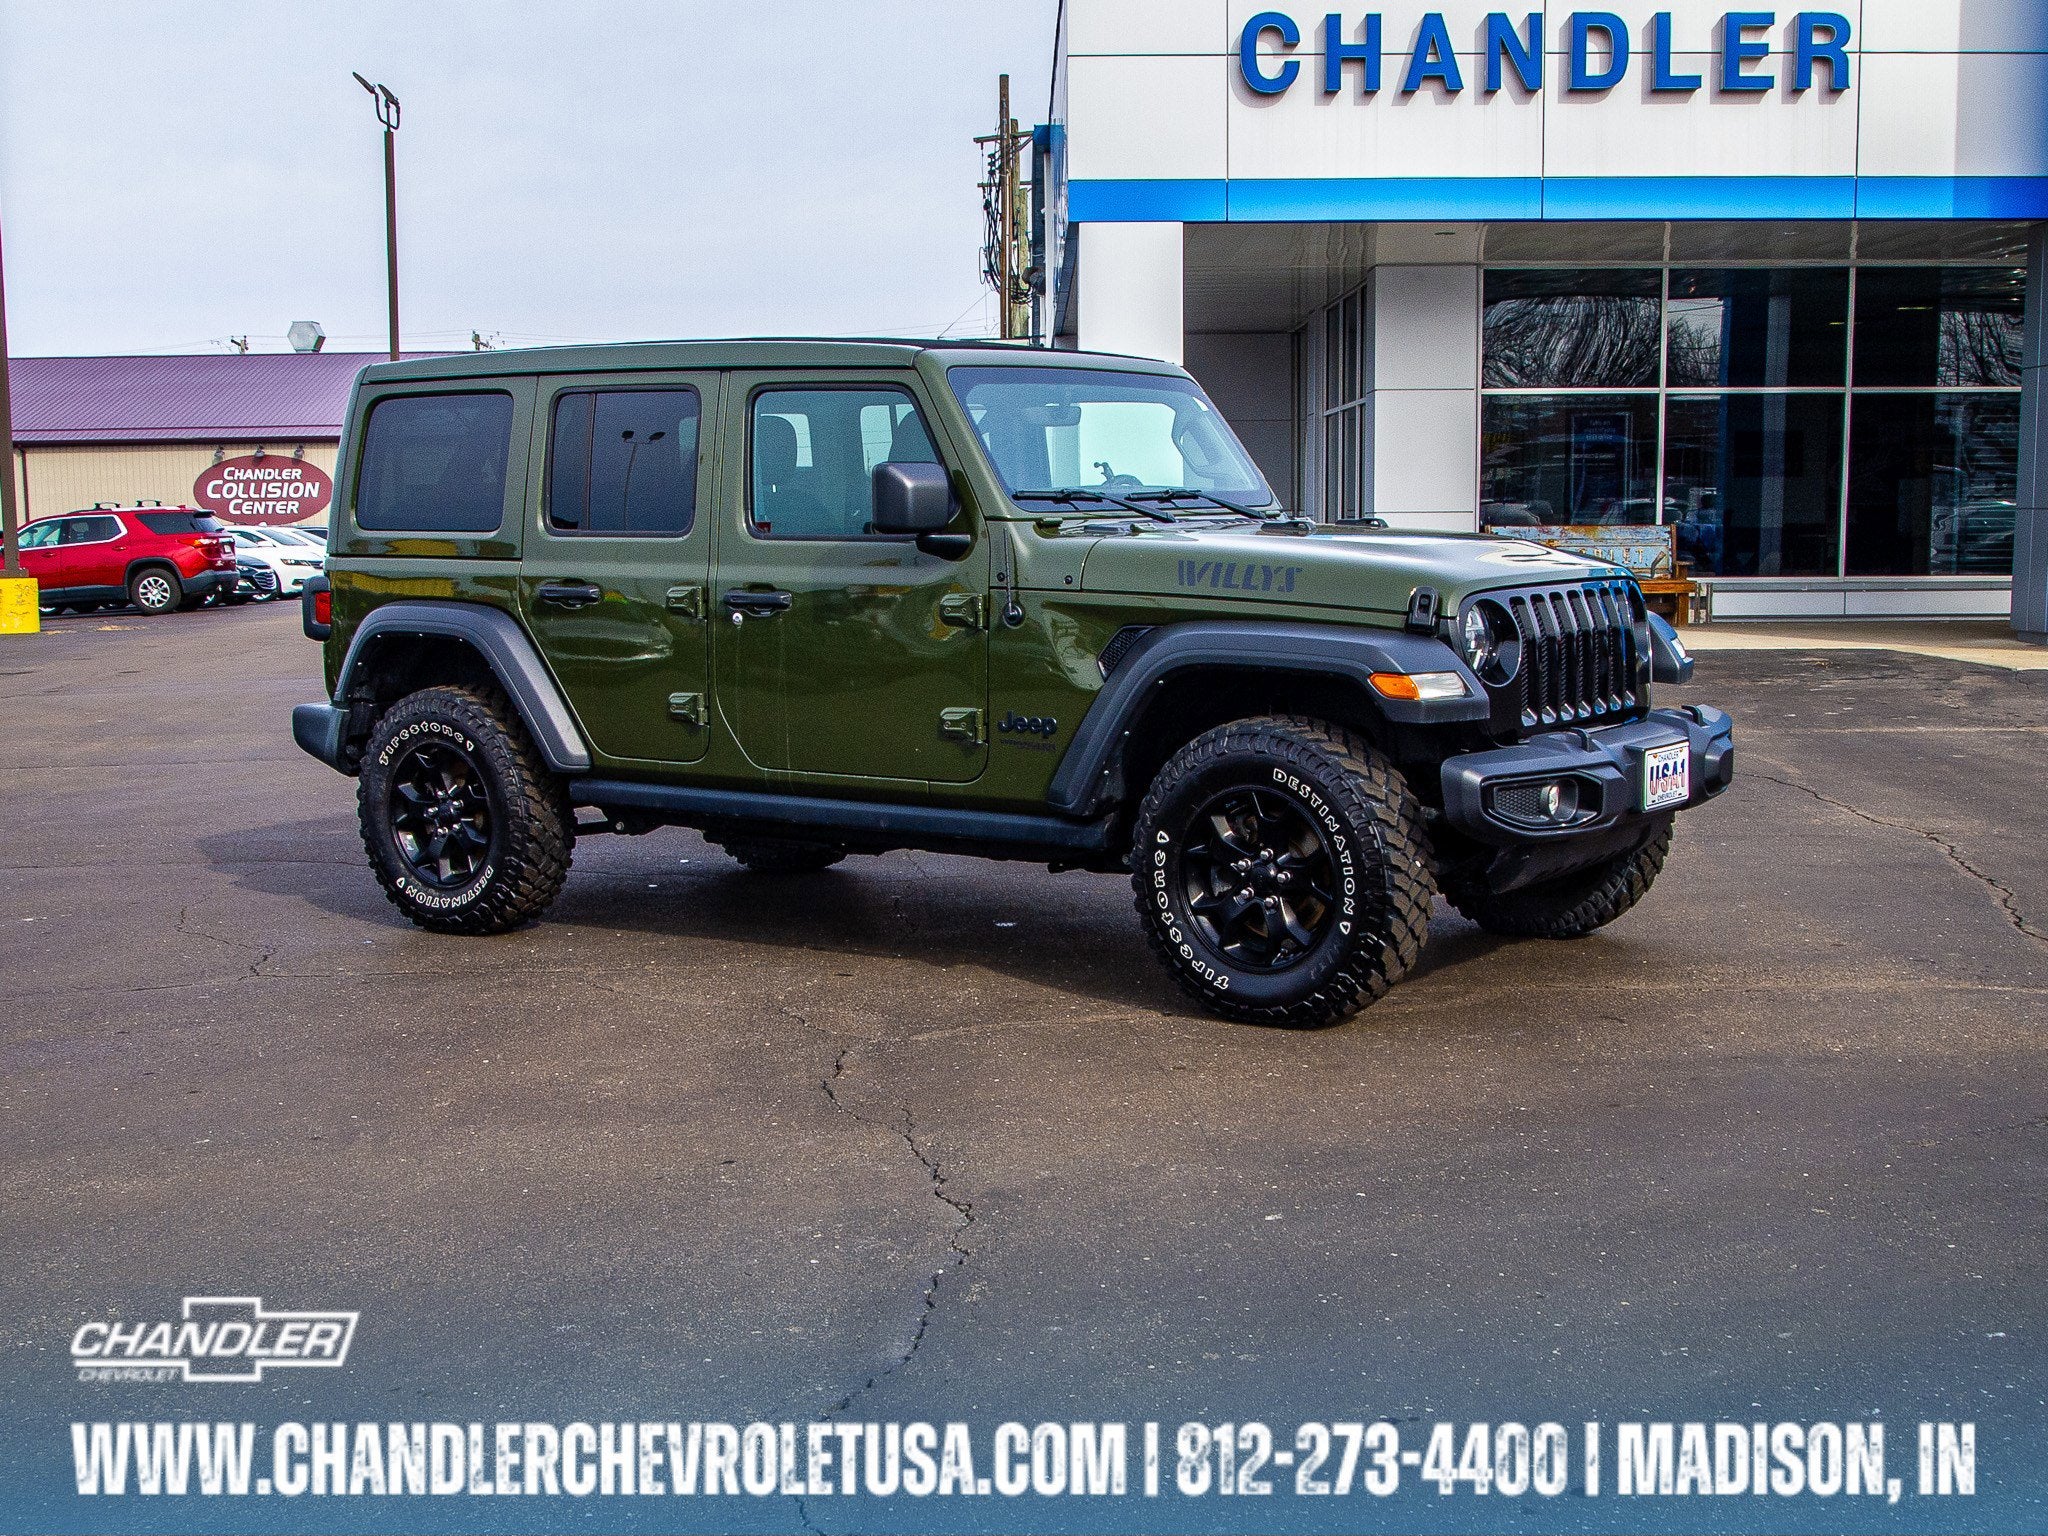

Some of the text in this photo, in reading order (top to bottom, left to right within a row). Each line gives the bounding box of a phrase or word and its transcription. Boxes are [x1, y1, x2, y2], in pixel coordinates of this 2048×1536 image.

[1239, 12, 1852, 95] CHANDLER
[223, 467, 302, 480] CHANDLER
[206, 480, 320, 499] COLLISION
[228, 499, 299, 515] CENTER
[1177, 559, 1303, 593] WILLYS
[998, 710, 1057, 738] Jeep
[1272, 768, 1356, 916] DESTINATION
[405, 864, 494, 909] DESTINATION
